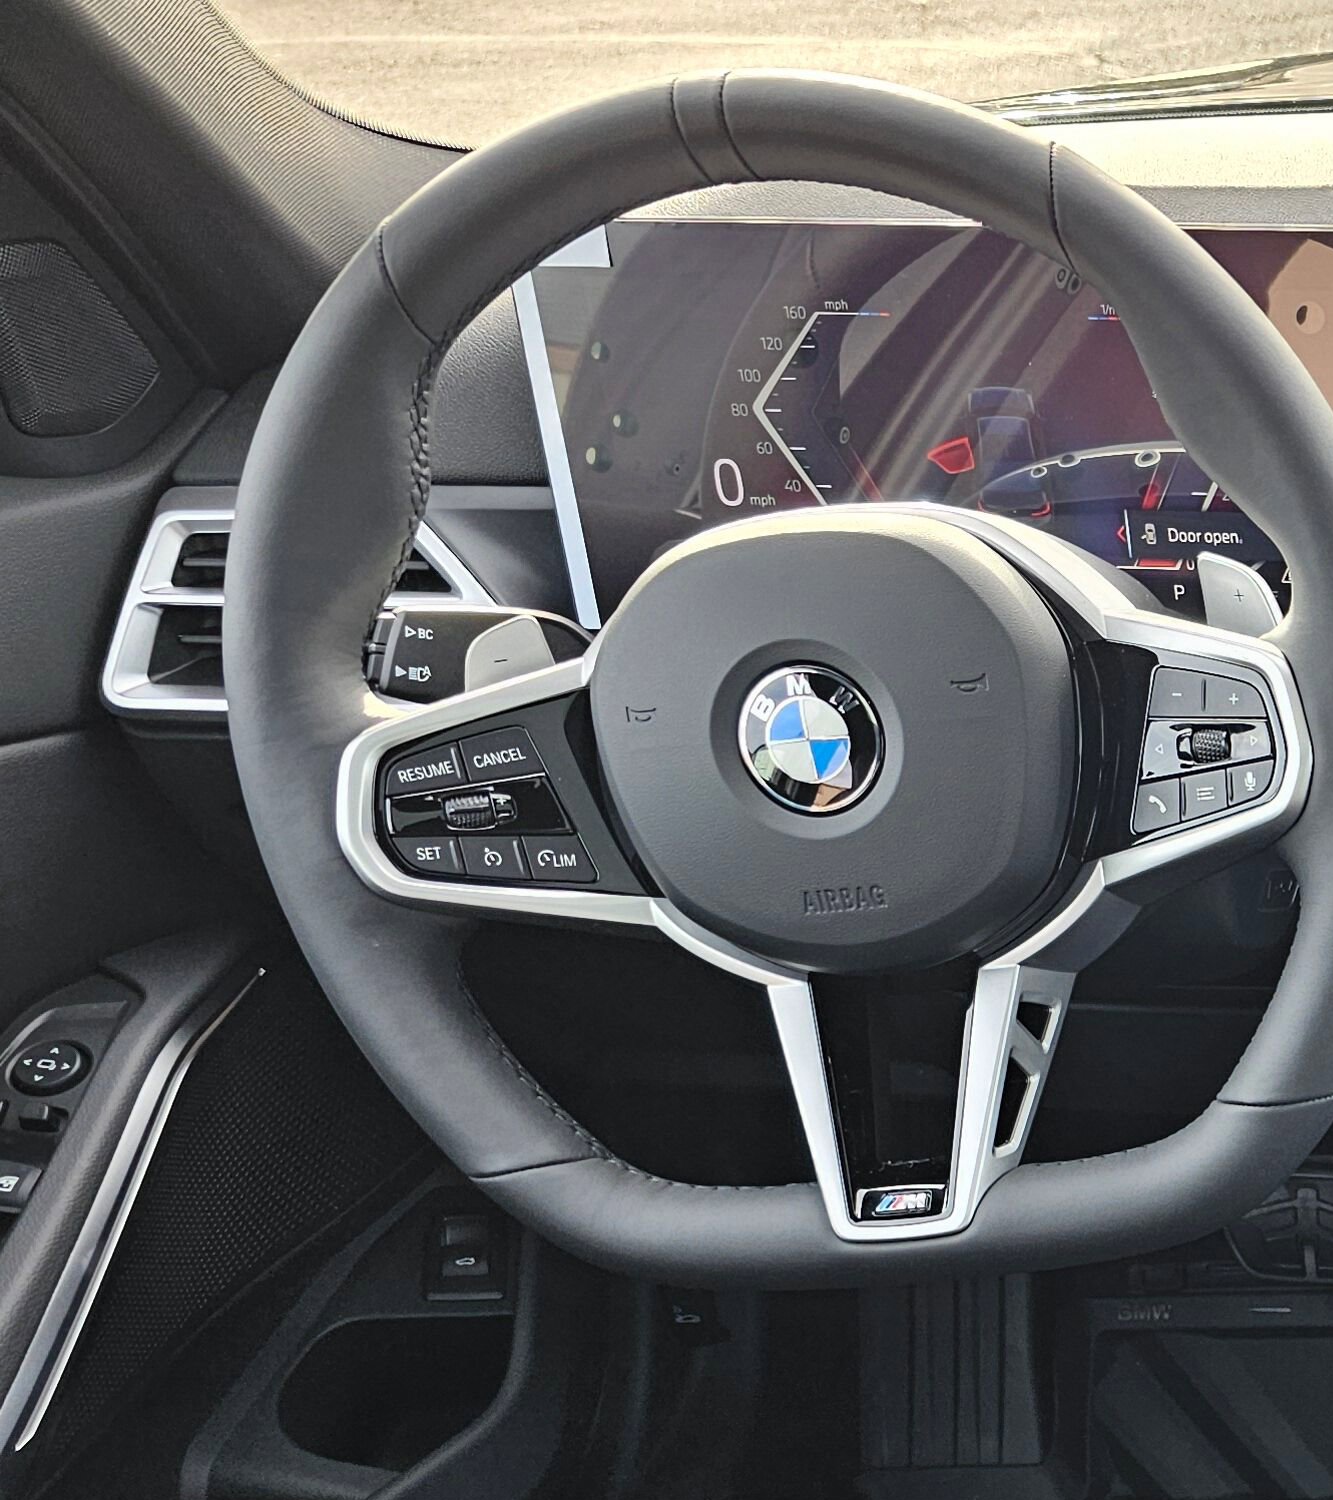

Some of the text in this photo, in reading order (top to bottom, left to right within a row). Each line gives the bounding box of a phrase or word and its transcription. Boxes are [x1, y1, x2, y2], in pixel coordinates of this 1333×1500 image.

[824, 299, 849, 311] mph
[784, 306, 806, 320] 160
[760, 337, 782, 350] 120
[737, 369, 761, 382] 100
[731, 404, 748, 417] 80
[756, 442, 773, 455] 60
[714, 458, 776, 507] 0 mph
[785, 480, 801, 493] 40
[1167, 527, 1244, 547] Door open.
[1173, 584, 1186, 600] P
[417, 628, 434, 640] BC
[750, 673, 860, 722] BMW
[473, 747, 527, 769] CANCEL
[397, 760, 455, 783] RESUME
[416, 846, 442, 861] SET
[553, 854, 577, 868] LIM
[802, 883, 889, 916] AIRBAG
